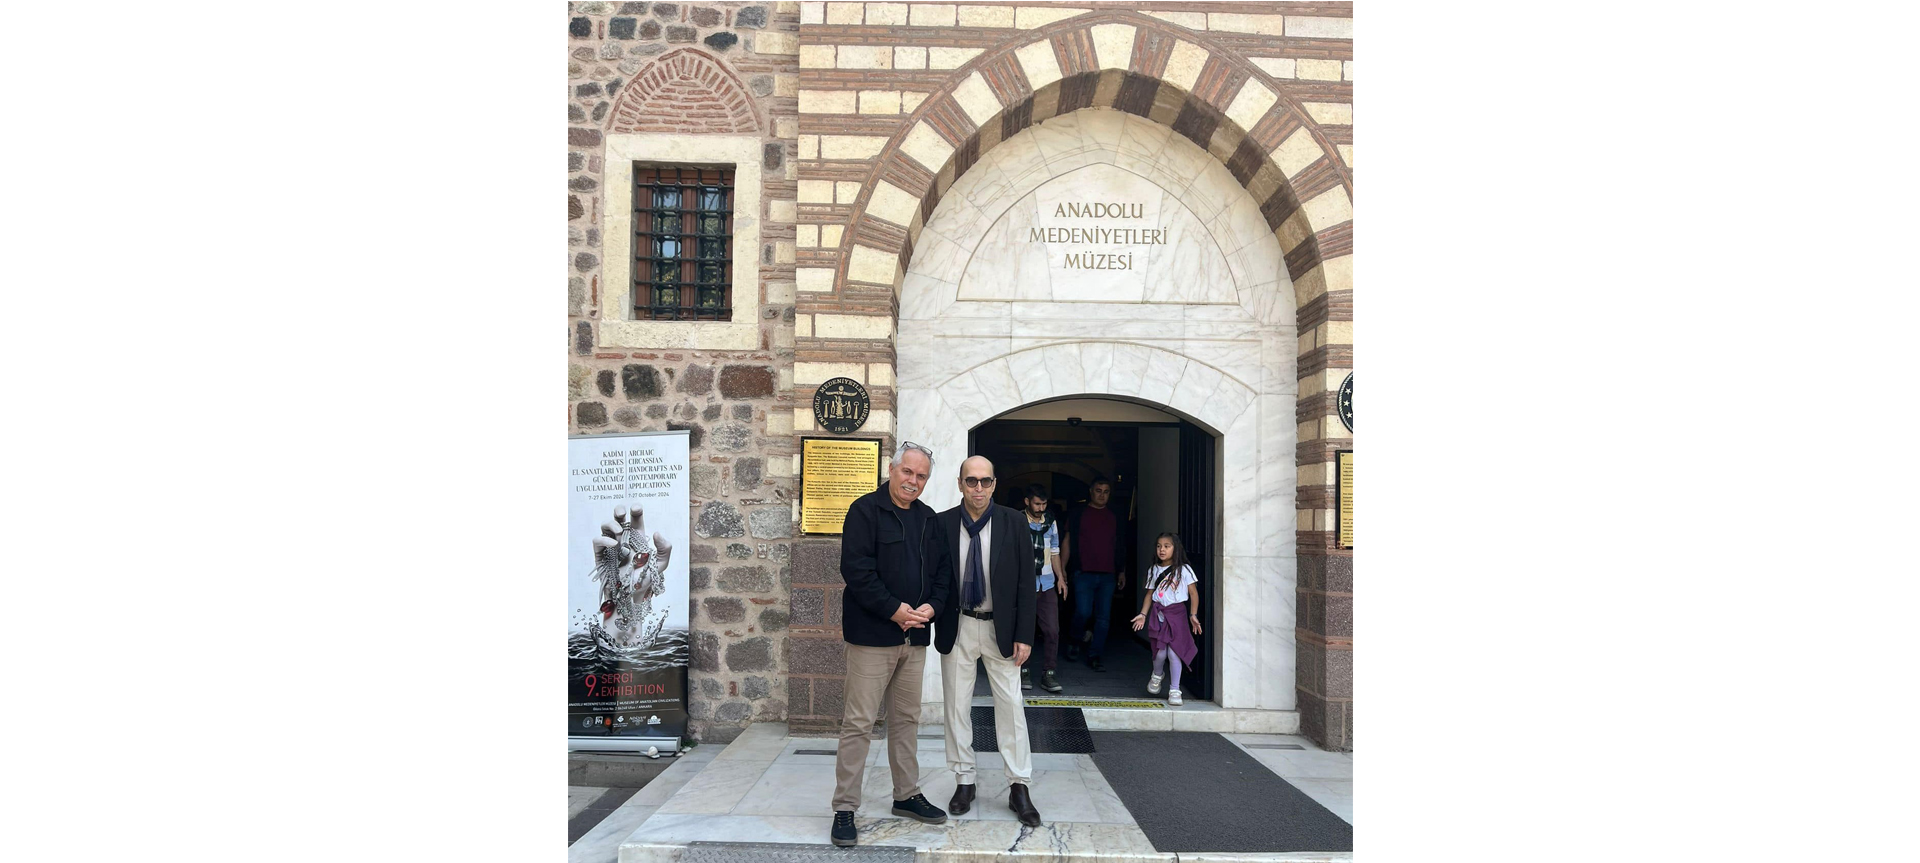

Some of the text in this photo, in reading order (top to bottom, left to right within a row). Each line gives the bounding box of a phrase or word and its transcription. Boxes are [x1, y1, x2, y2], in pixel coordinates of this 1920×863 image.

[1054, 202, 1143, 219] ANADOLU
[1029, 225, 1167, 245] MEDENİYETLERİ
[1063, 251, 1132, 270] MÜZESİ
[814, 395, 829, 426] ANADOLU
[602, 450, 624, 458] KADİM
[628, 449, 654, 457] ARCHAIC
[600, 459, 624, 467] ÇERKES
[628, 457, 663, 465] CIRCASSIAN
[581, 467, 615, 476] SANATLARI
[628, 465, 668, 473] HANDCRAFTS
[592, 475, 625, 483] GÜNÜMÜZ
[628, 473, 678, 481] CONTEMPORARY
[576, 483, 624, 493] UYGULAMALARI
[628, 481, 671, 490] APPLICATIONS
[601, 670, 633, 684] SERGİ
[585, 674, 600, 697] 9.
[601, 683, 665, 697] EXHIBITION
